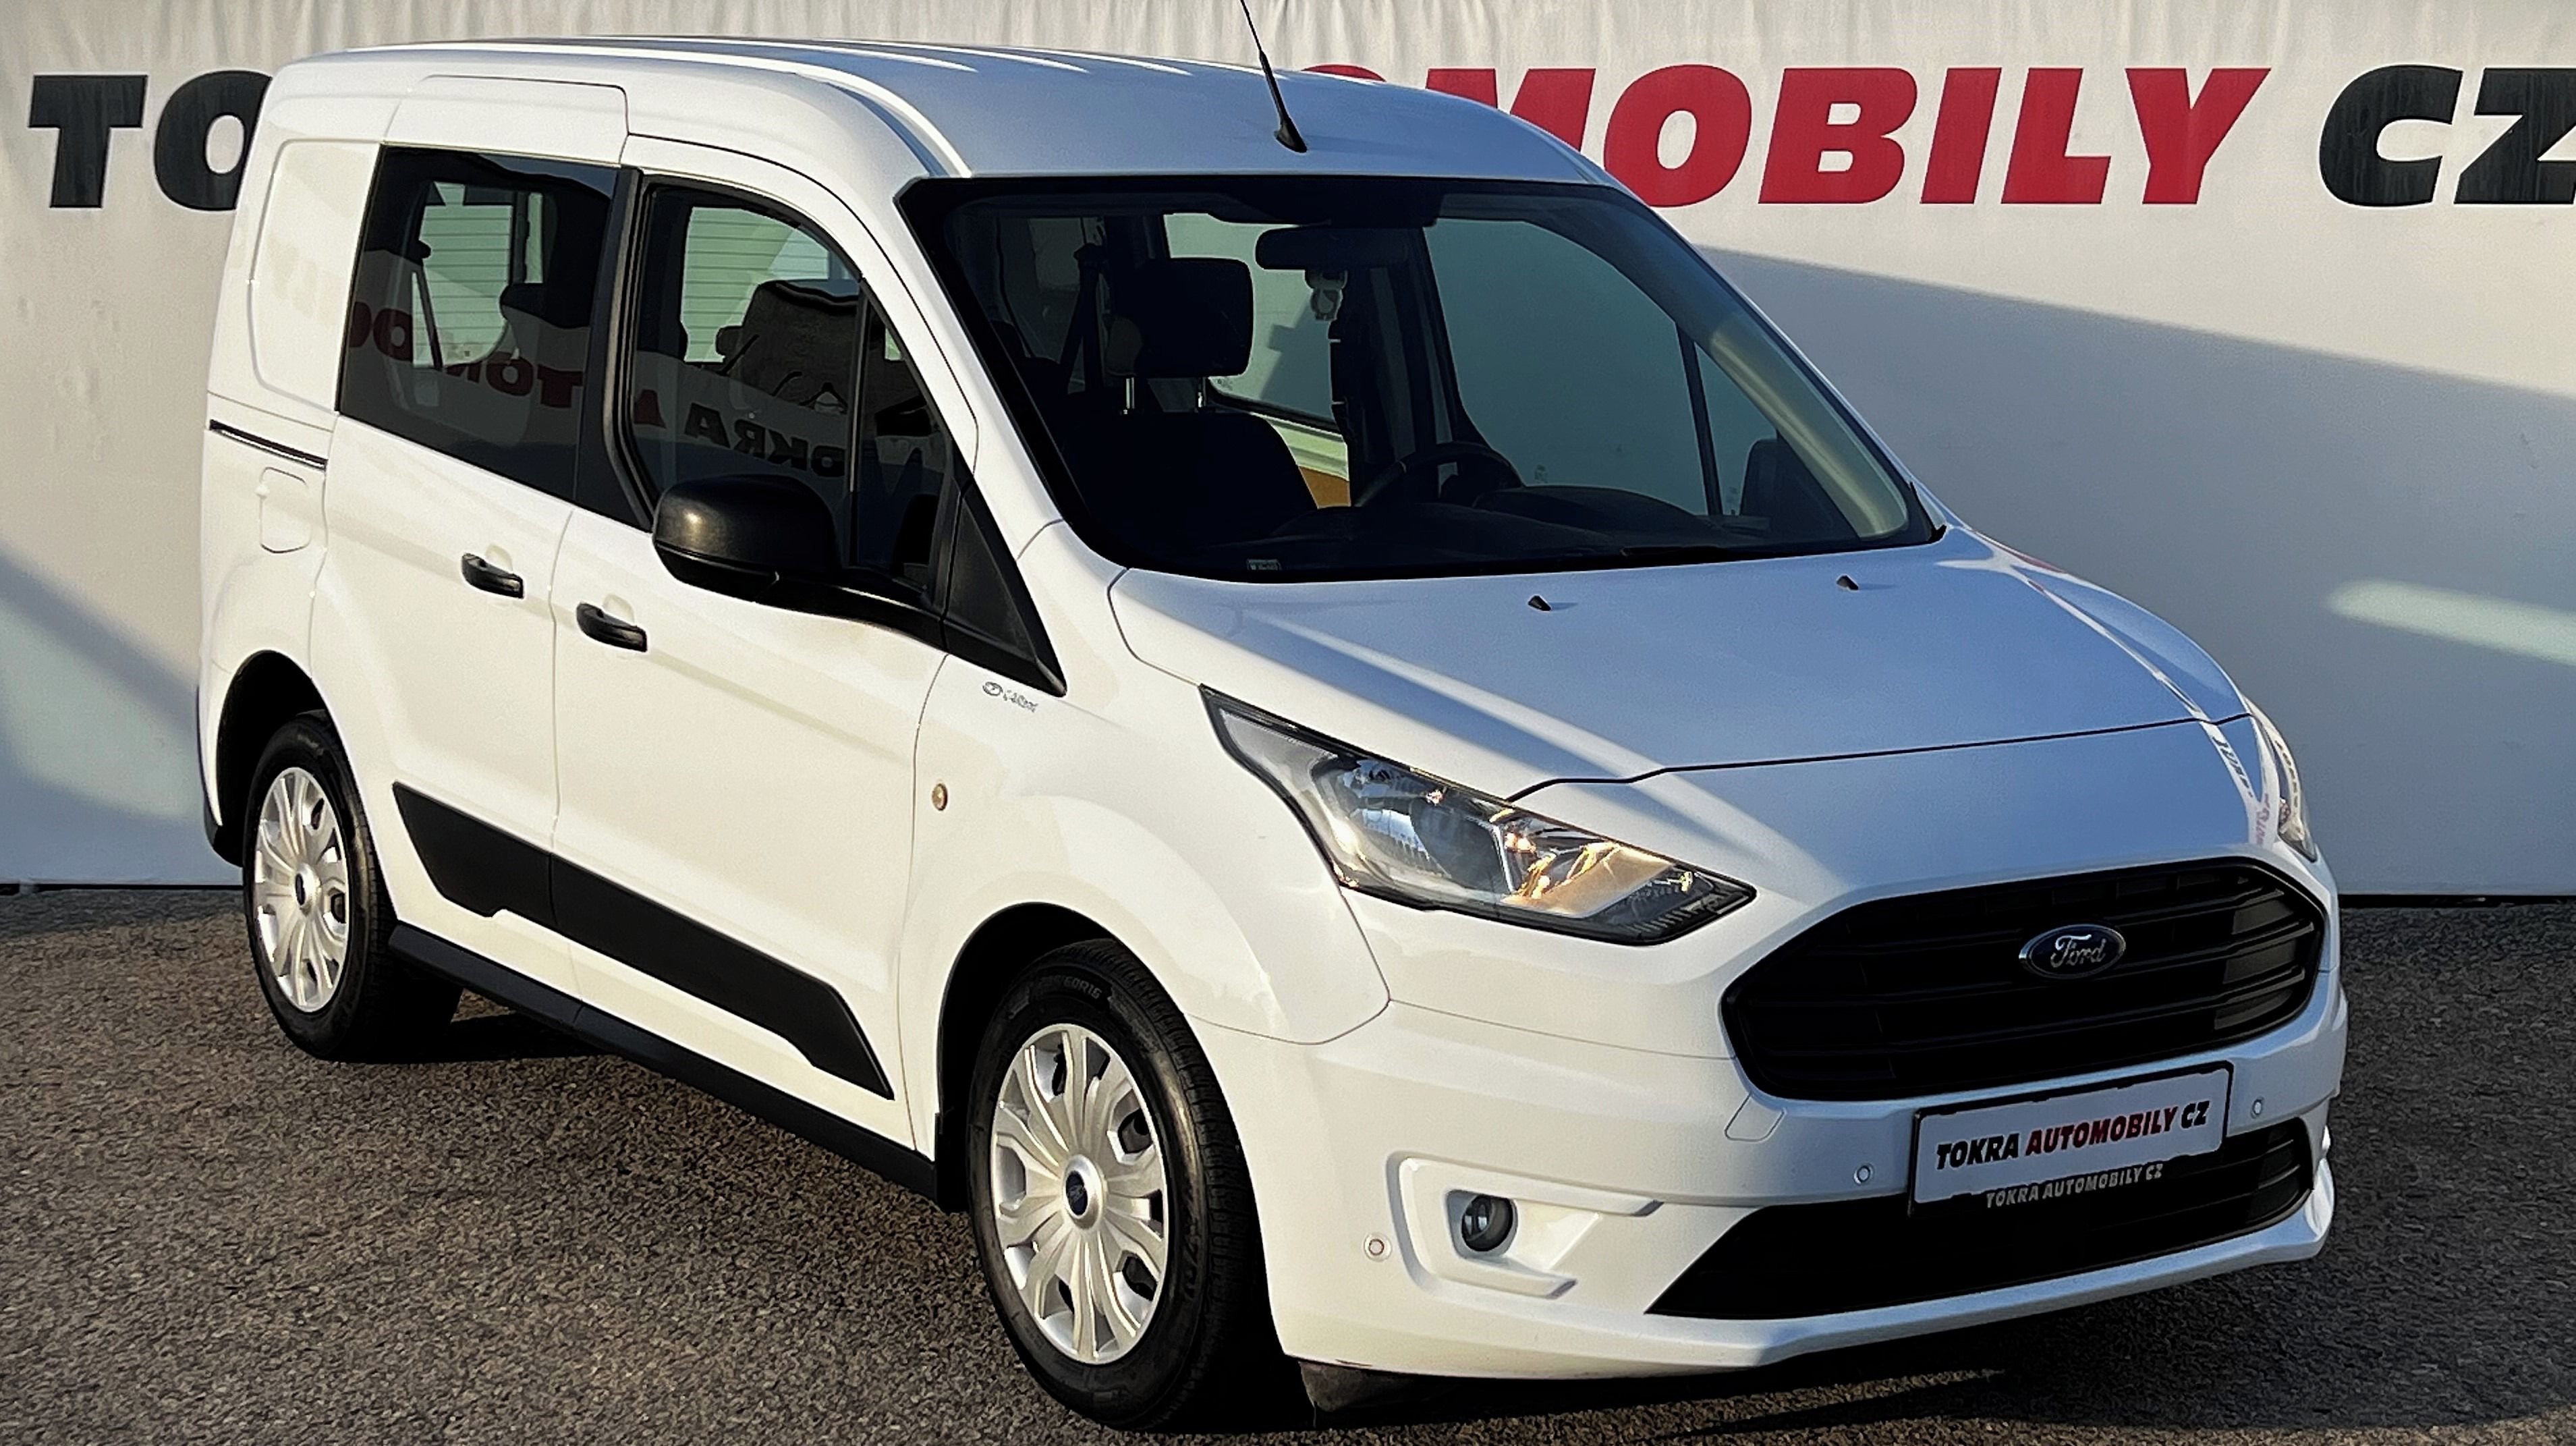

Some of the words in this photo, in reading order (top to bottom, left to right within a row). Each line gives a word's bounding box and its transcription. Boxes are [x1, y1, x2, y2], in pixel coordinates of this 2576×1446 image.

[2318, 63, 2576, 207] CZ
[2050, 934, 2106, 968] Ford
[1936, 1132, 2020, 1170] TOKRA
[2025, 1105, 2179, 1157] AUTOMOBILY
[2181, 1100, 2210, 1129] CZ
[1986, 1188, 2039, 1208] TOKRA
[2042, 1166, 2142, 1198] AUTOMOBILY
[2146, 1163, 2164, 1180] CZ
